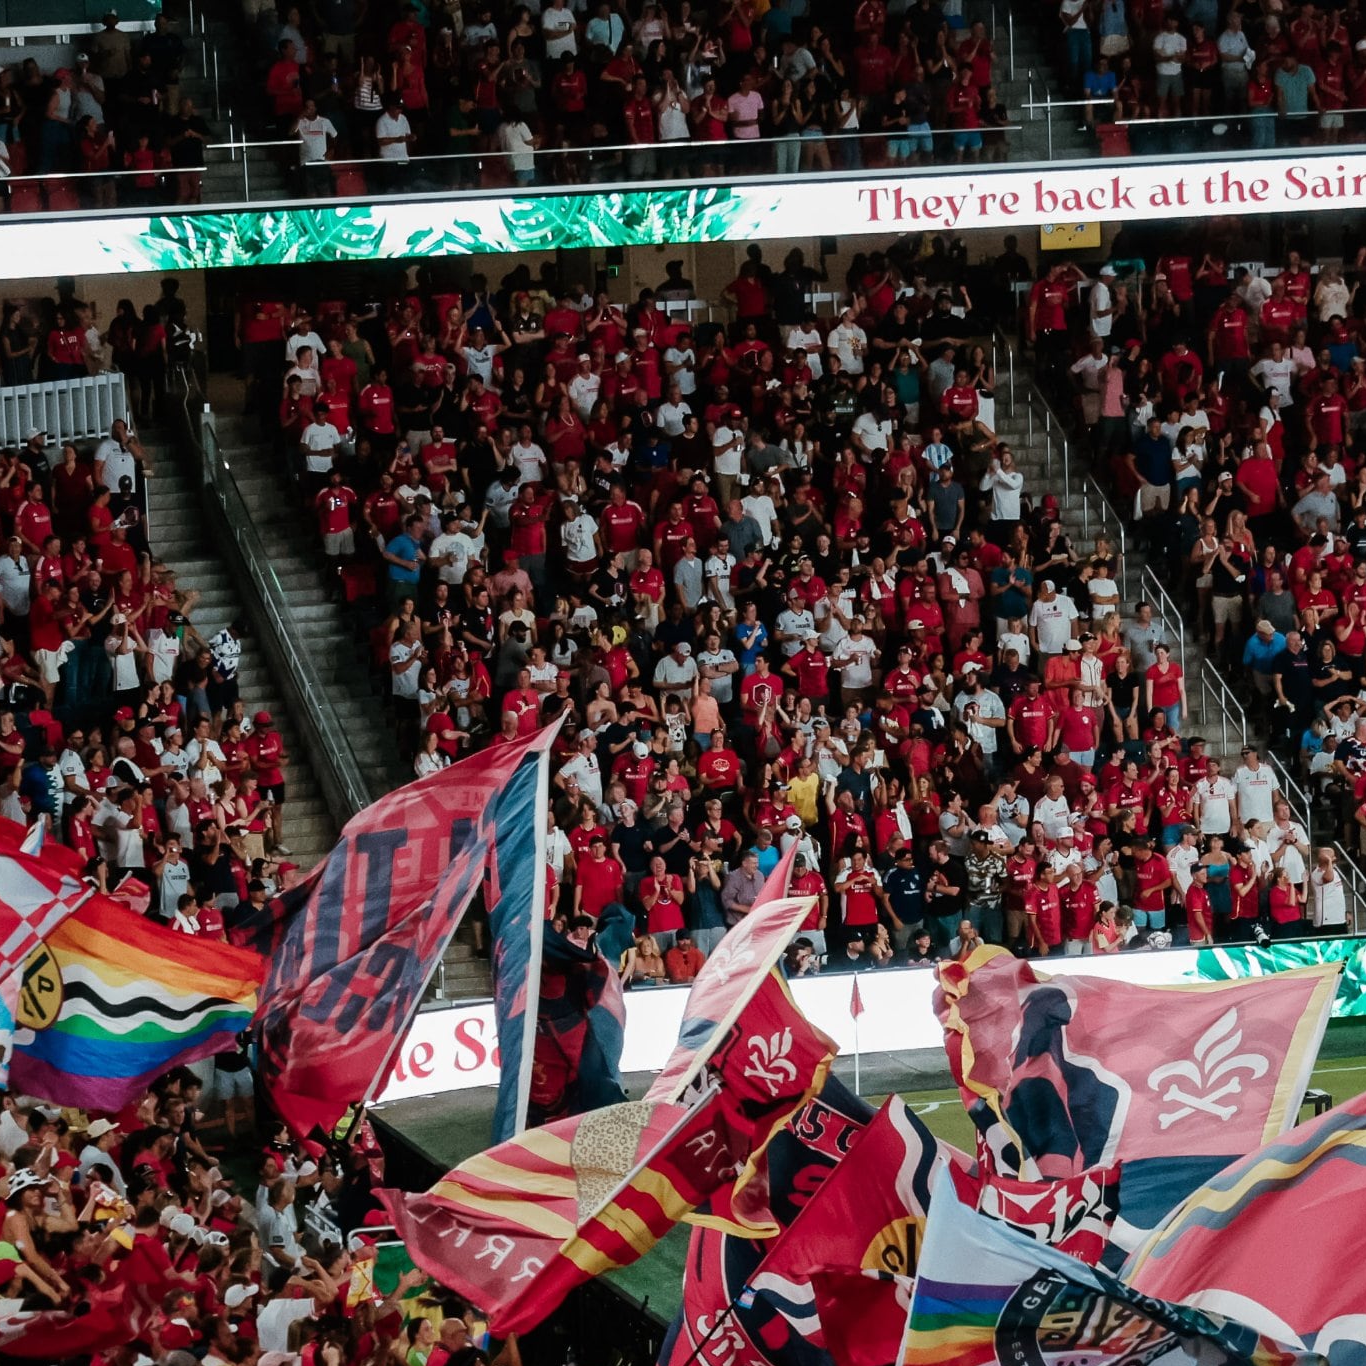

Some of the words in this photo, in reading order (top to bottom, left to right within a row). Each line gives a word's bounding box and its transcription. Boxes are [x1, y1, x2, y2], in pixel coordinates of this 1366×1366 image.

[858, 182, 1020, 228] They're
[1034, 175, 1136, 213] back
[1149, 176, 1190, 207] at
[1202, 169, 1269, 204] the
